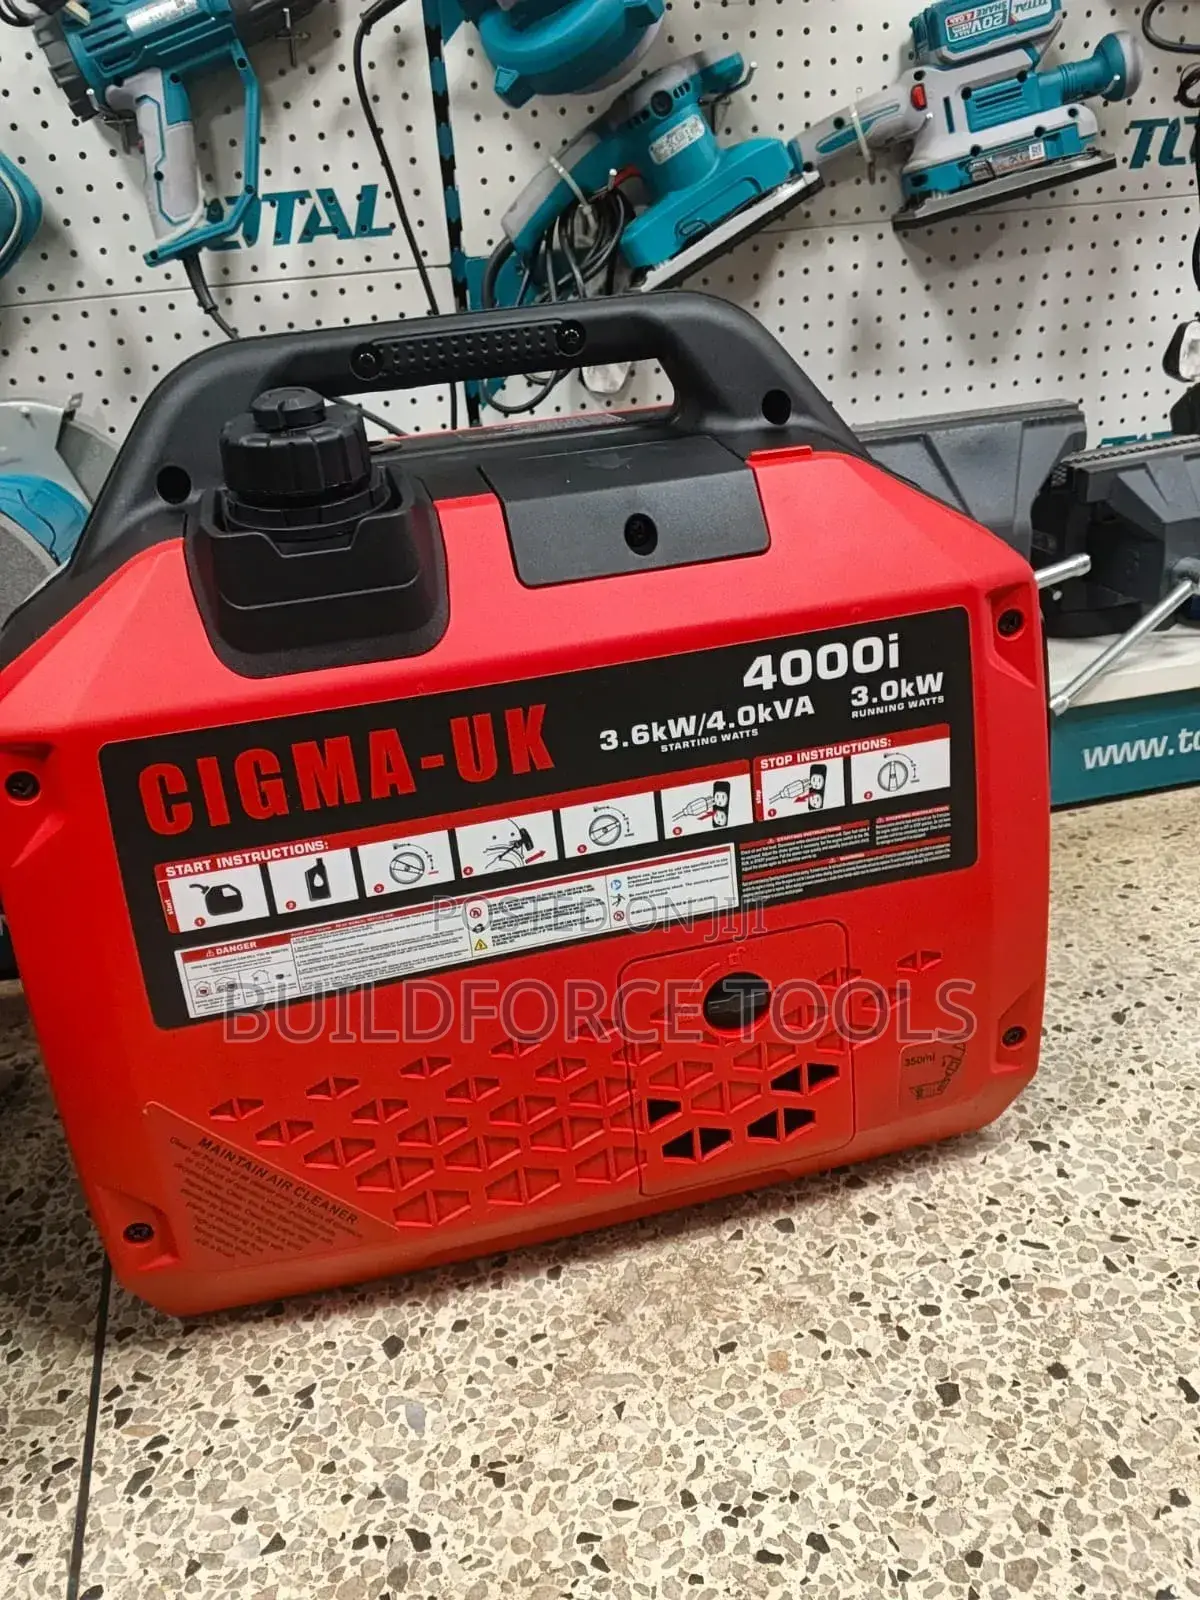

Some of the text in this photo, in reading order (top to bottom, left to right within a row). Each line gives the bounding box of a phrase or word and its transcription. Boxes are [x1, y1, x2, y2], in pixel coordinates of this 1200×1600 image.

[971, 14, 1003, 32] 20V
[203, 184, 394, 251] OTAL
[743, 633, 900, 691] 4000i
[599, 672, 945, 752] 3.6kW/4.0kVA 3.0kW
[851, 695, 945, 719] RUNNING WATTS
[660, 729, 759, 753] STARTING WATTS
[760, 738, 893, 770] STOP INSTRUCTIONS:
[138, 703, 555, 836] CIGMA-UK
[165, 840, 330, 877] START INSTRUCTIONS:
[215, 941, 258, 956] DANGER
[903, 1054, 936, 1067] 350ml
[197, 1137, 360, 1225] MAINTAIN AIR CLEANER
